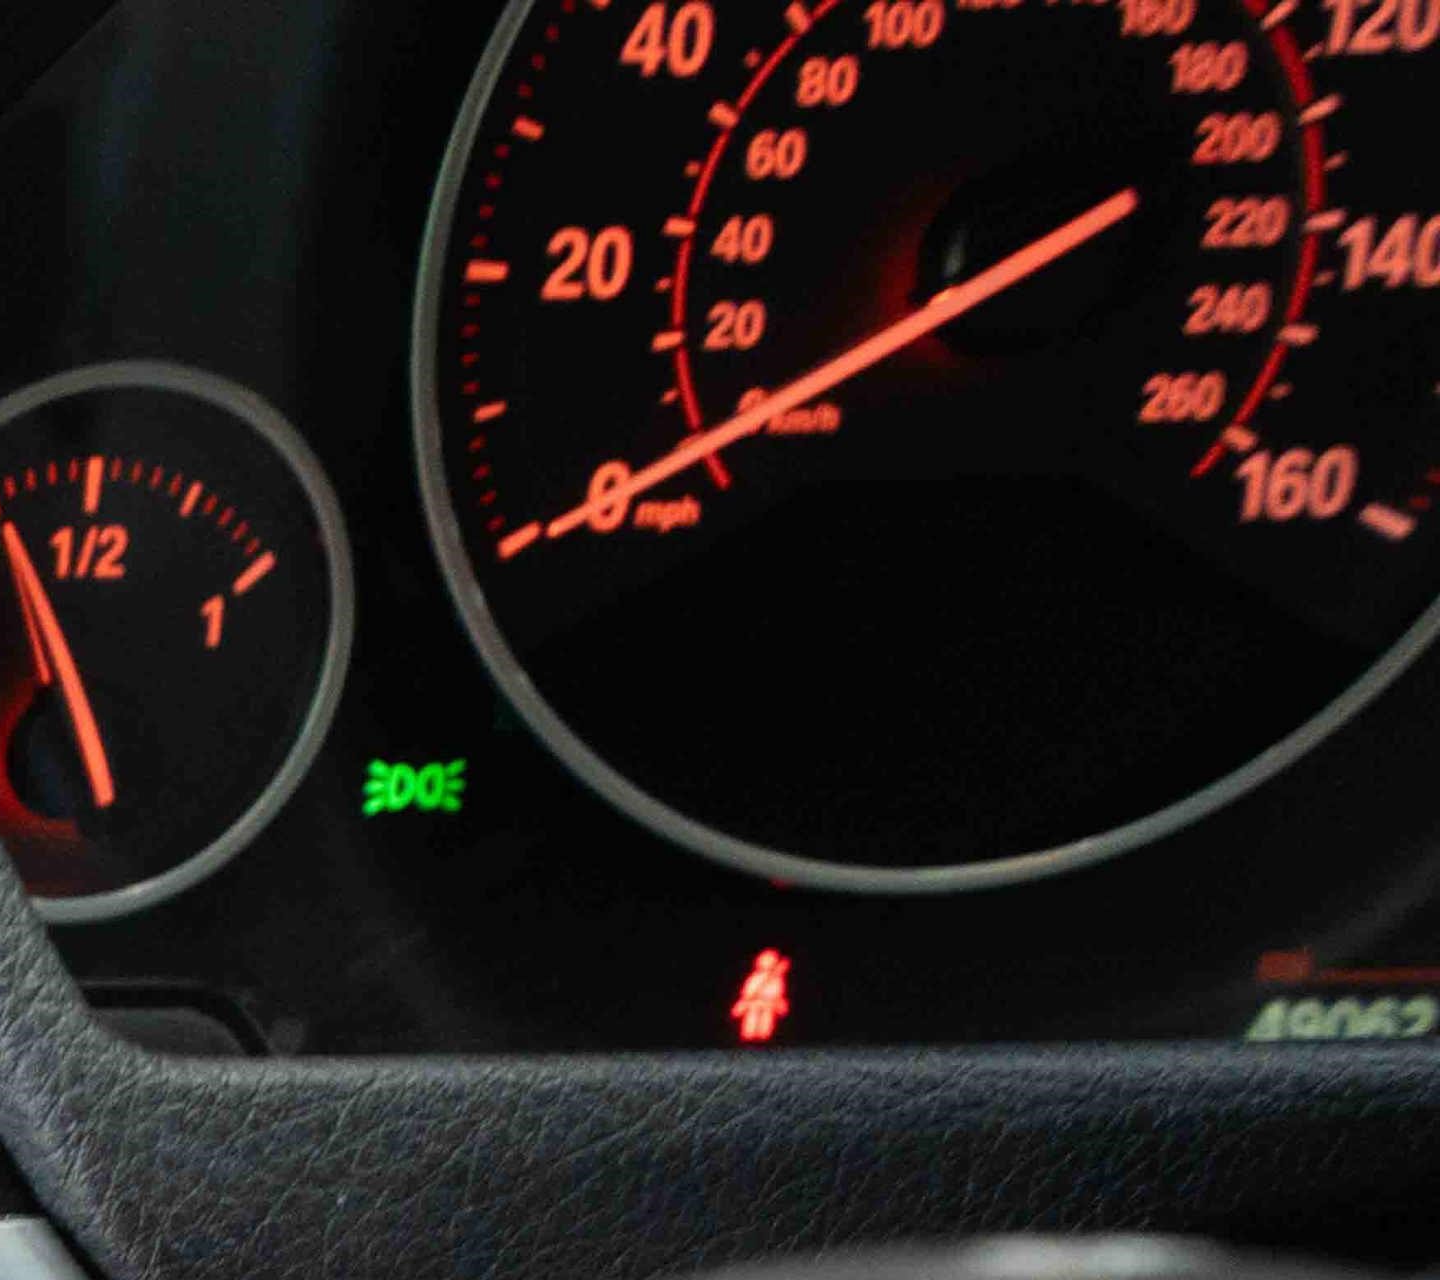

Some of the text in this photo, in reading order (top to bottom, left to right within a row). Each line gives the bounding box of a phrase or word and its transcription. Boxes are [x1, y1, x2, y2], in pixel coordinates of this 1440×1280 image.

[620, 0, 714, 77] 40
[864, 0, 945, 49] 100
[1323, 0, 1440, 54] 120
[795, 54, 860, 107] 80
[1168, 41, 1248, 93] 180
[745, 128, 808, 180] 60
[1191, 112, 1284, 165] 200
[710, 213, 774, 264] 40
[1202, 196, 1290, 249] 220
[539, 224, 634, 301] 20
[1338, 212, 1440, 290] 140
[703, 299, 766, 351] 20
[1184, 283, 1270, 335] 240
[1138, 370, 1226, 423] 260
[1236, 445, 1357, 522] 160
[49, 523, 130, 581] 1/2
[199, 594, 225, 650] 1
